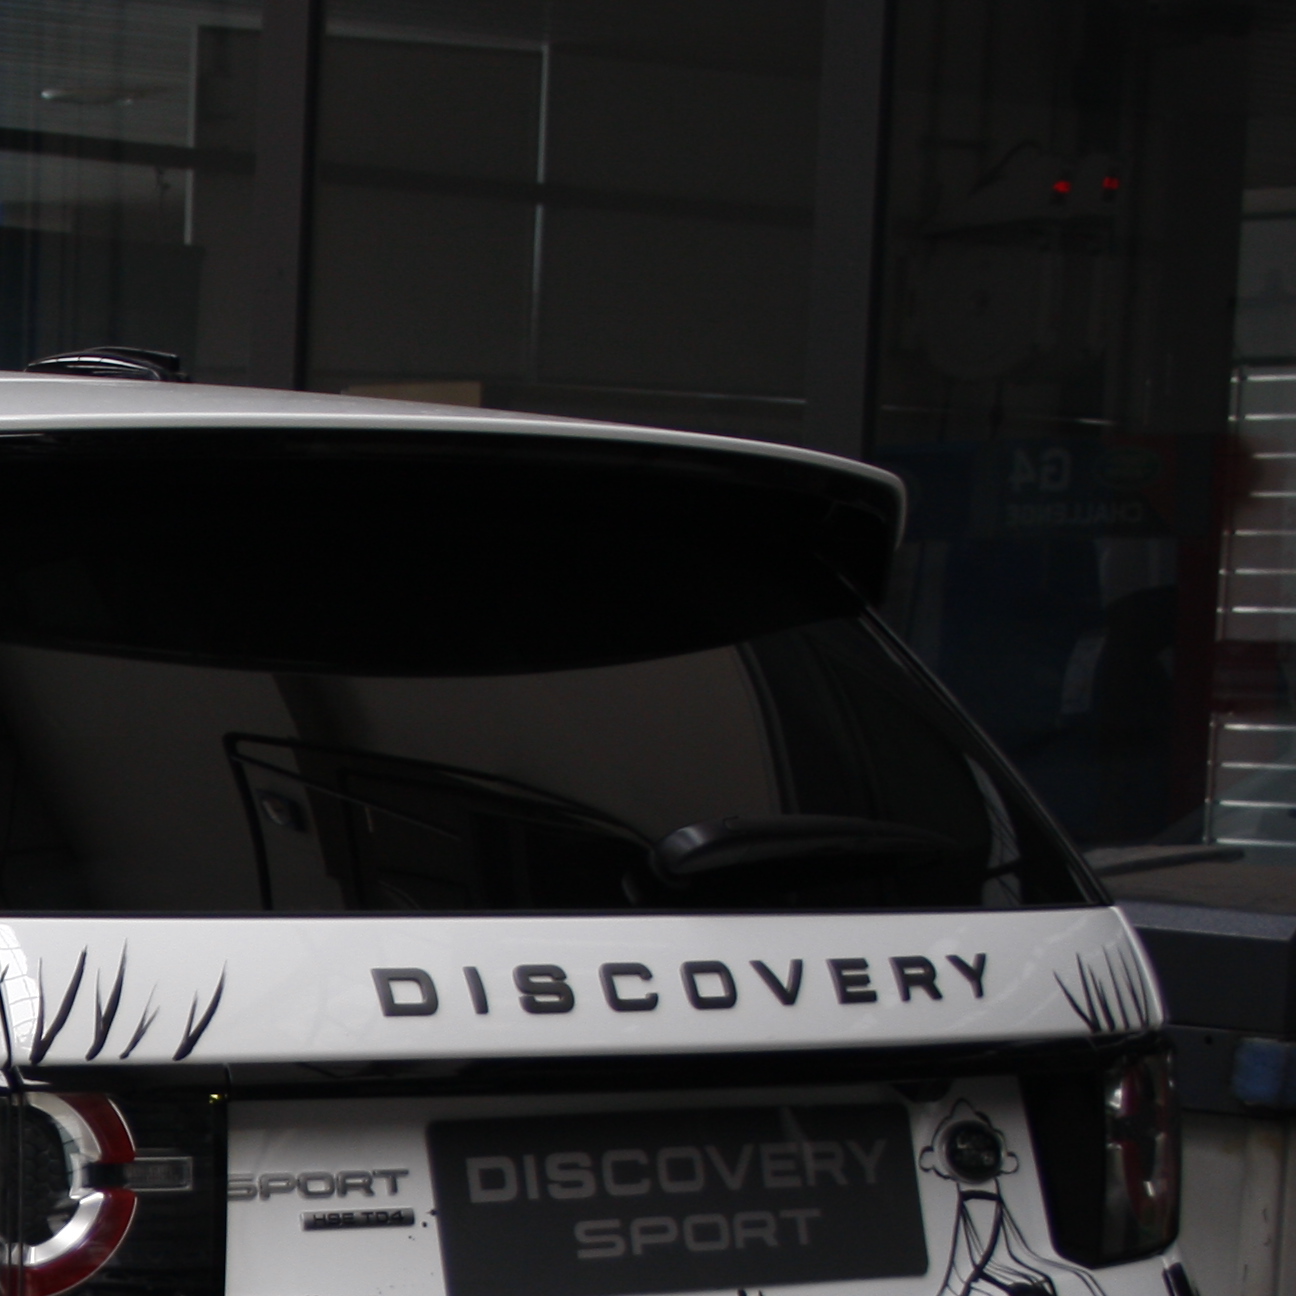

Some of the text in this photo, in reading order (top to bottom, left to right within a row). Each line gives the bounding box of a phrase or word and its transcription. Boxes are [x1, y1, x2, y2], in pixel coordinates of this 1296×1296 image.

[370, 951, 987, 1018] DISCOVERY
[226, 1168, 410, 1201] SPORT
[464, 1138, 888, 1205] DISCOVERY
[312, 1208, 405, 1227] HSE TD4
[573, 1207, 822, 1260] SPORT
